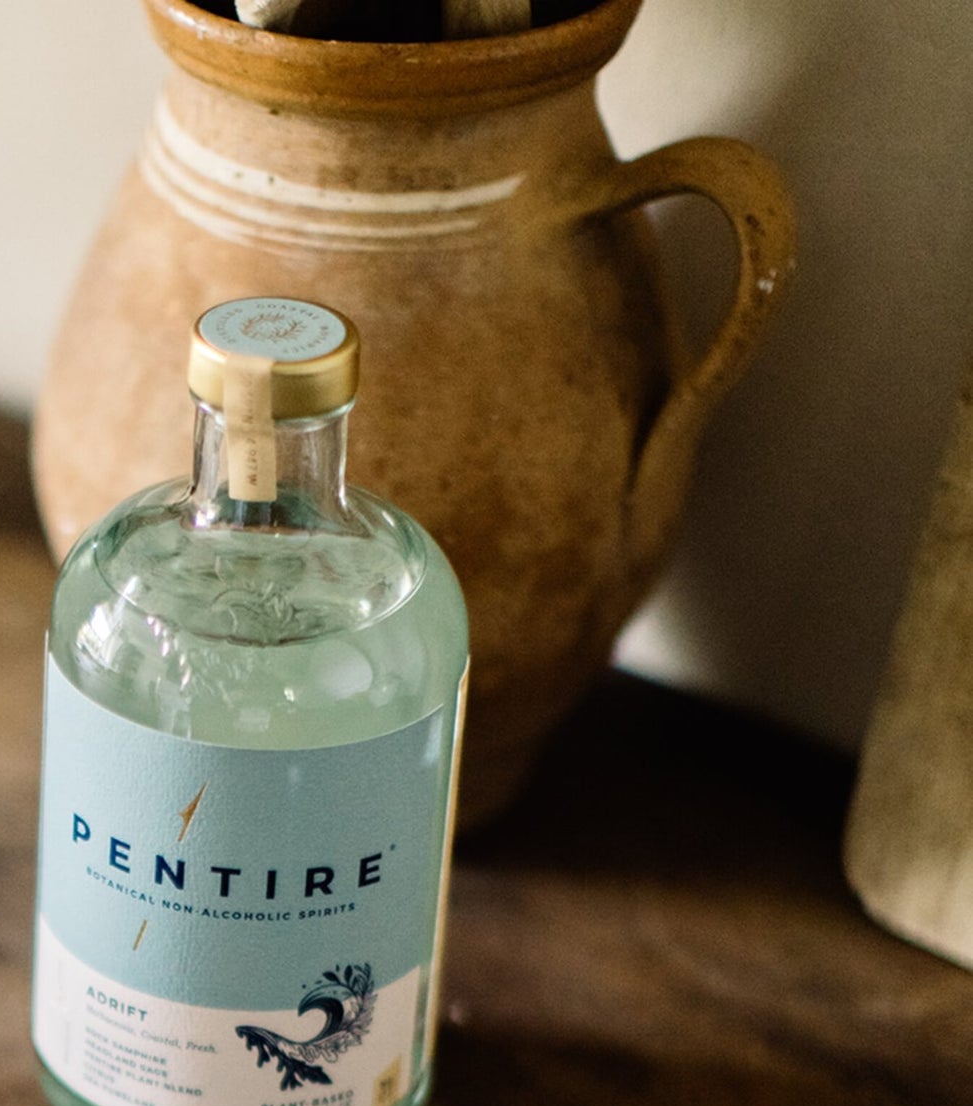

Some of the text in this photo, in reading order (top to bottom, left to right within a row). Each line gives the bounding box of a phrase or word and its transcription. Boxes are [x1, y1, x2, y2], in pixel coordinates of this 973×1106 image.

[72, 813, 383, 900] PENTIRE
[86, 865, 156, 906] BOTANICAL
[298, 902, 357, 920] SPIRITS
[86, 986, 147, 1021] ADRIFT
[126, 1071, 159, 1087] PLANT
[164, 1083, 203, 1096] BLEND
